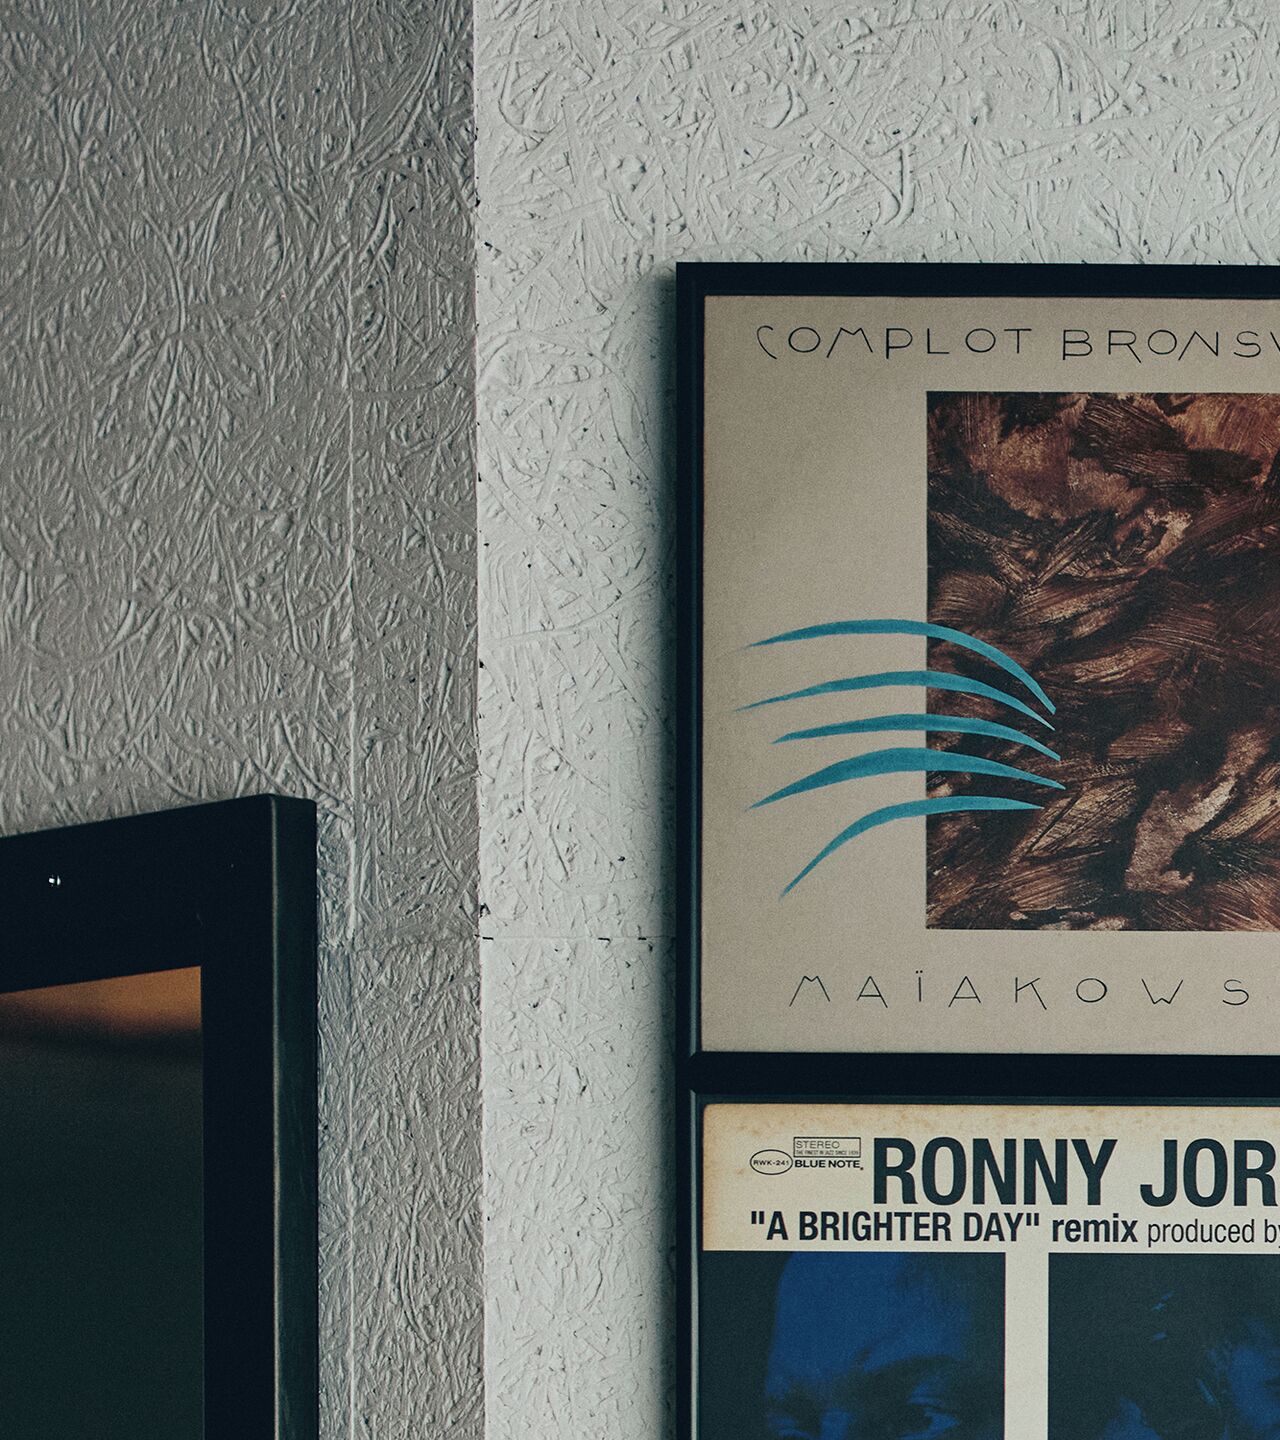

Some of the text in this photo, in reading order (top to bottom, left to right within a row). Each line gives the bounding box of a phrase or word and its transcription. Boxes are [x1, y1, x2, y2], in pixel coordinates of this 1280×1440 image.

[756, 324, 1033, 360] COMPLOT
[795, 1160, 826, 1168] BLUE
[873, 1136, 1119, 1206] RONNY
[799, 1210, 952, 1242] BRIGHTER
[1052, 1212, 1139, 1243] remix
[1147, 1218, 1255, 1248] produced
